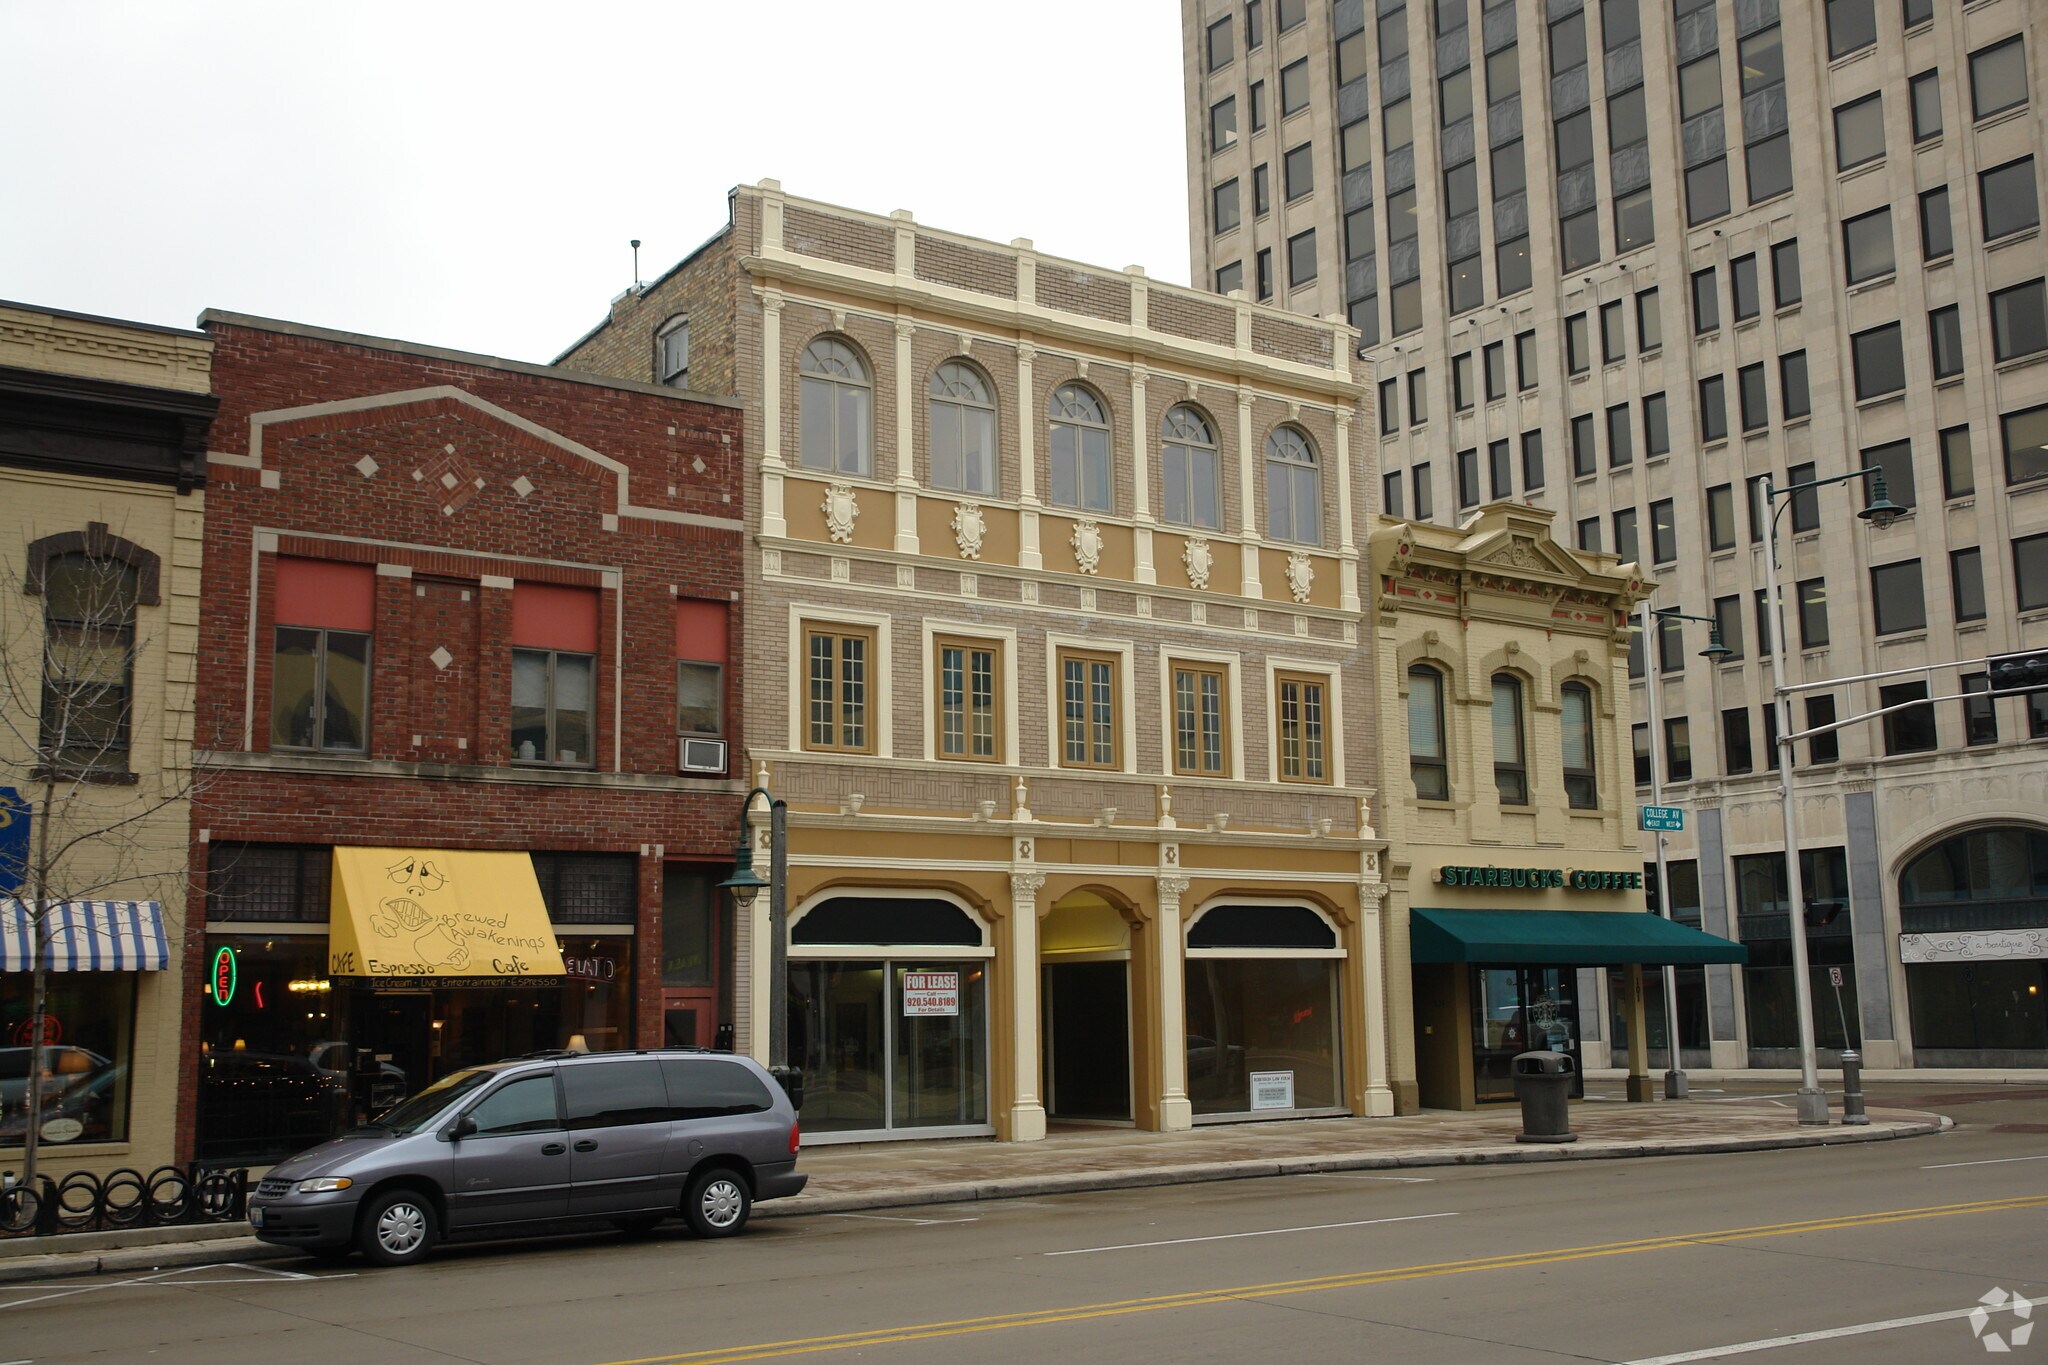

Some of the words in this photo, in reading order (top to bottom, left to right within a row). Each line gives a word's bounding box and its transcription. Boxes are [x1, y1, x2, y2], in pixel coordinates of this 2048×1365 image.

[1646, 808, 1669, 819] COLLEGE
[1672, 810, 1680, 819] AV
[1445, 865, 1564, 889] STARBUCKS
[1573, 869, 1643, 890] COFFEE
[441, 912, 508, 929] Brewed
[450, 926, 546, 954] Awakenings
[1984, 936, 2024, 954] boutique
[331, 951, 355, 974] CAFE
[368, 959, 435, 976] Espresso
[492, 954, 530, 975] Cafe
[565, 956, 616, 981] ELATO
[421, 978, 437, 987] Live
[906, 975, 926, 989] FOR
[927, 975, 957, 989] LEASE
